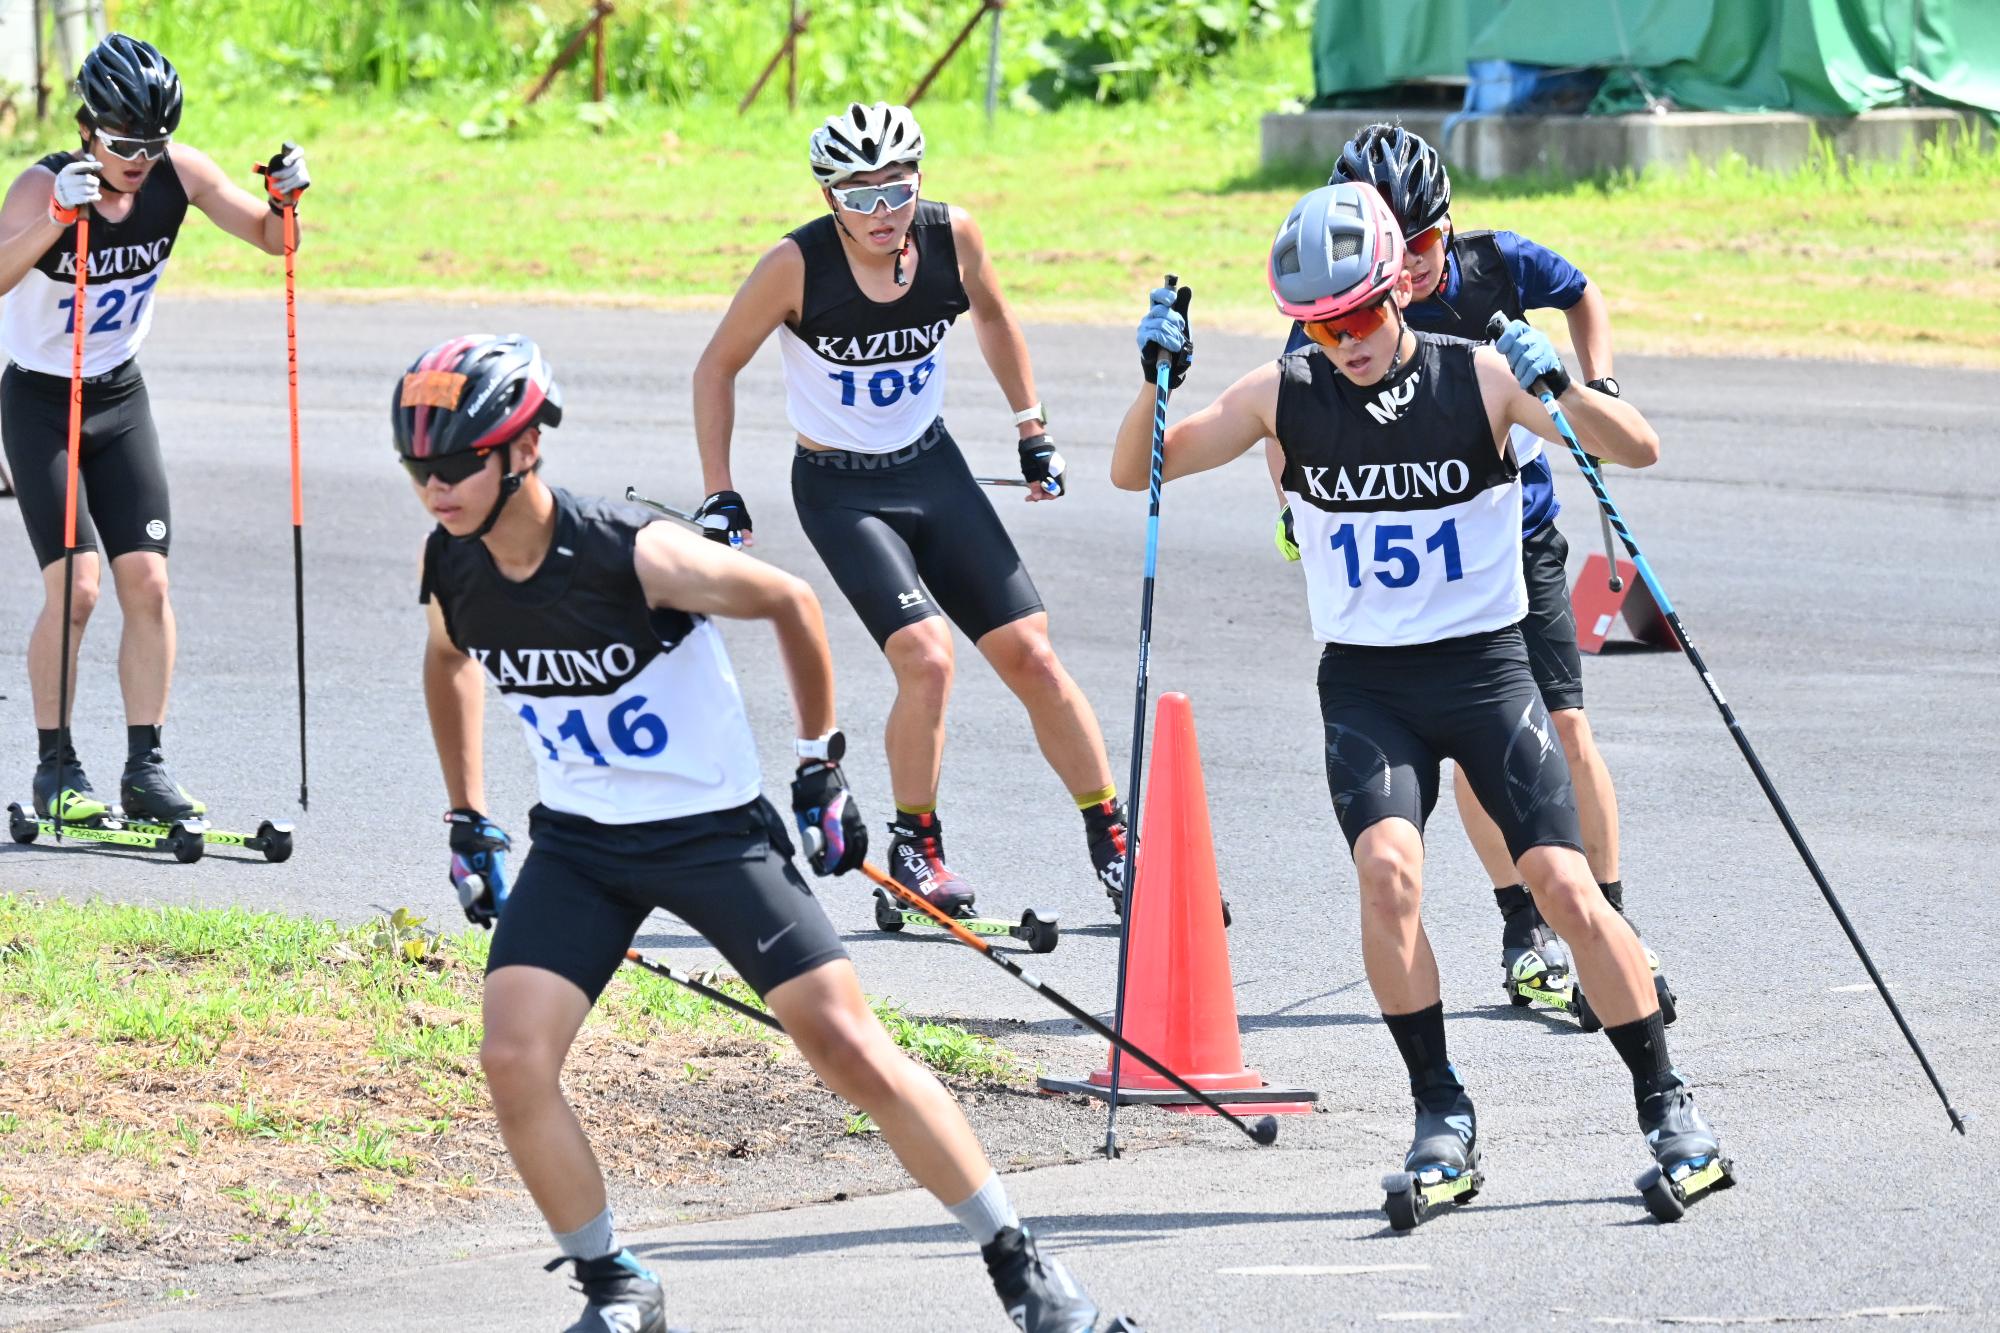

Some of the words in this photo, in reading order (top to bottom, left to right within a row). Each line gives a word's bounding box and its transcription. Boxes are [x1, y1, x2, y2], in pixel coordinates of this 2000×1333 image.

[58, 274, 158, 335] 127
[816, 319, 950, 361] KAZUNO
[1301, 459, 1470, 501] KAZUNO
[1330, 517, 1463, 588] 151
[519, 695, 668, 766] 116
